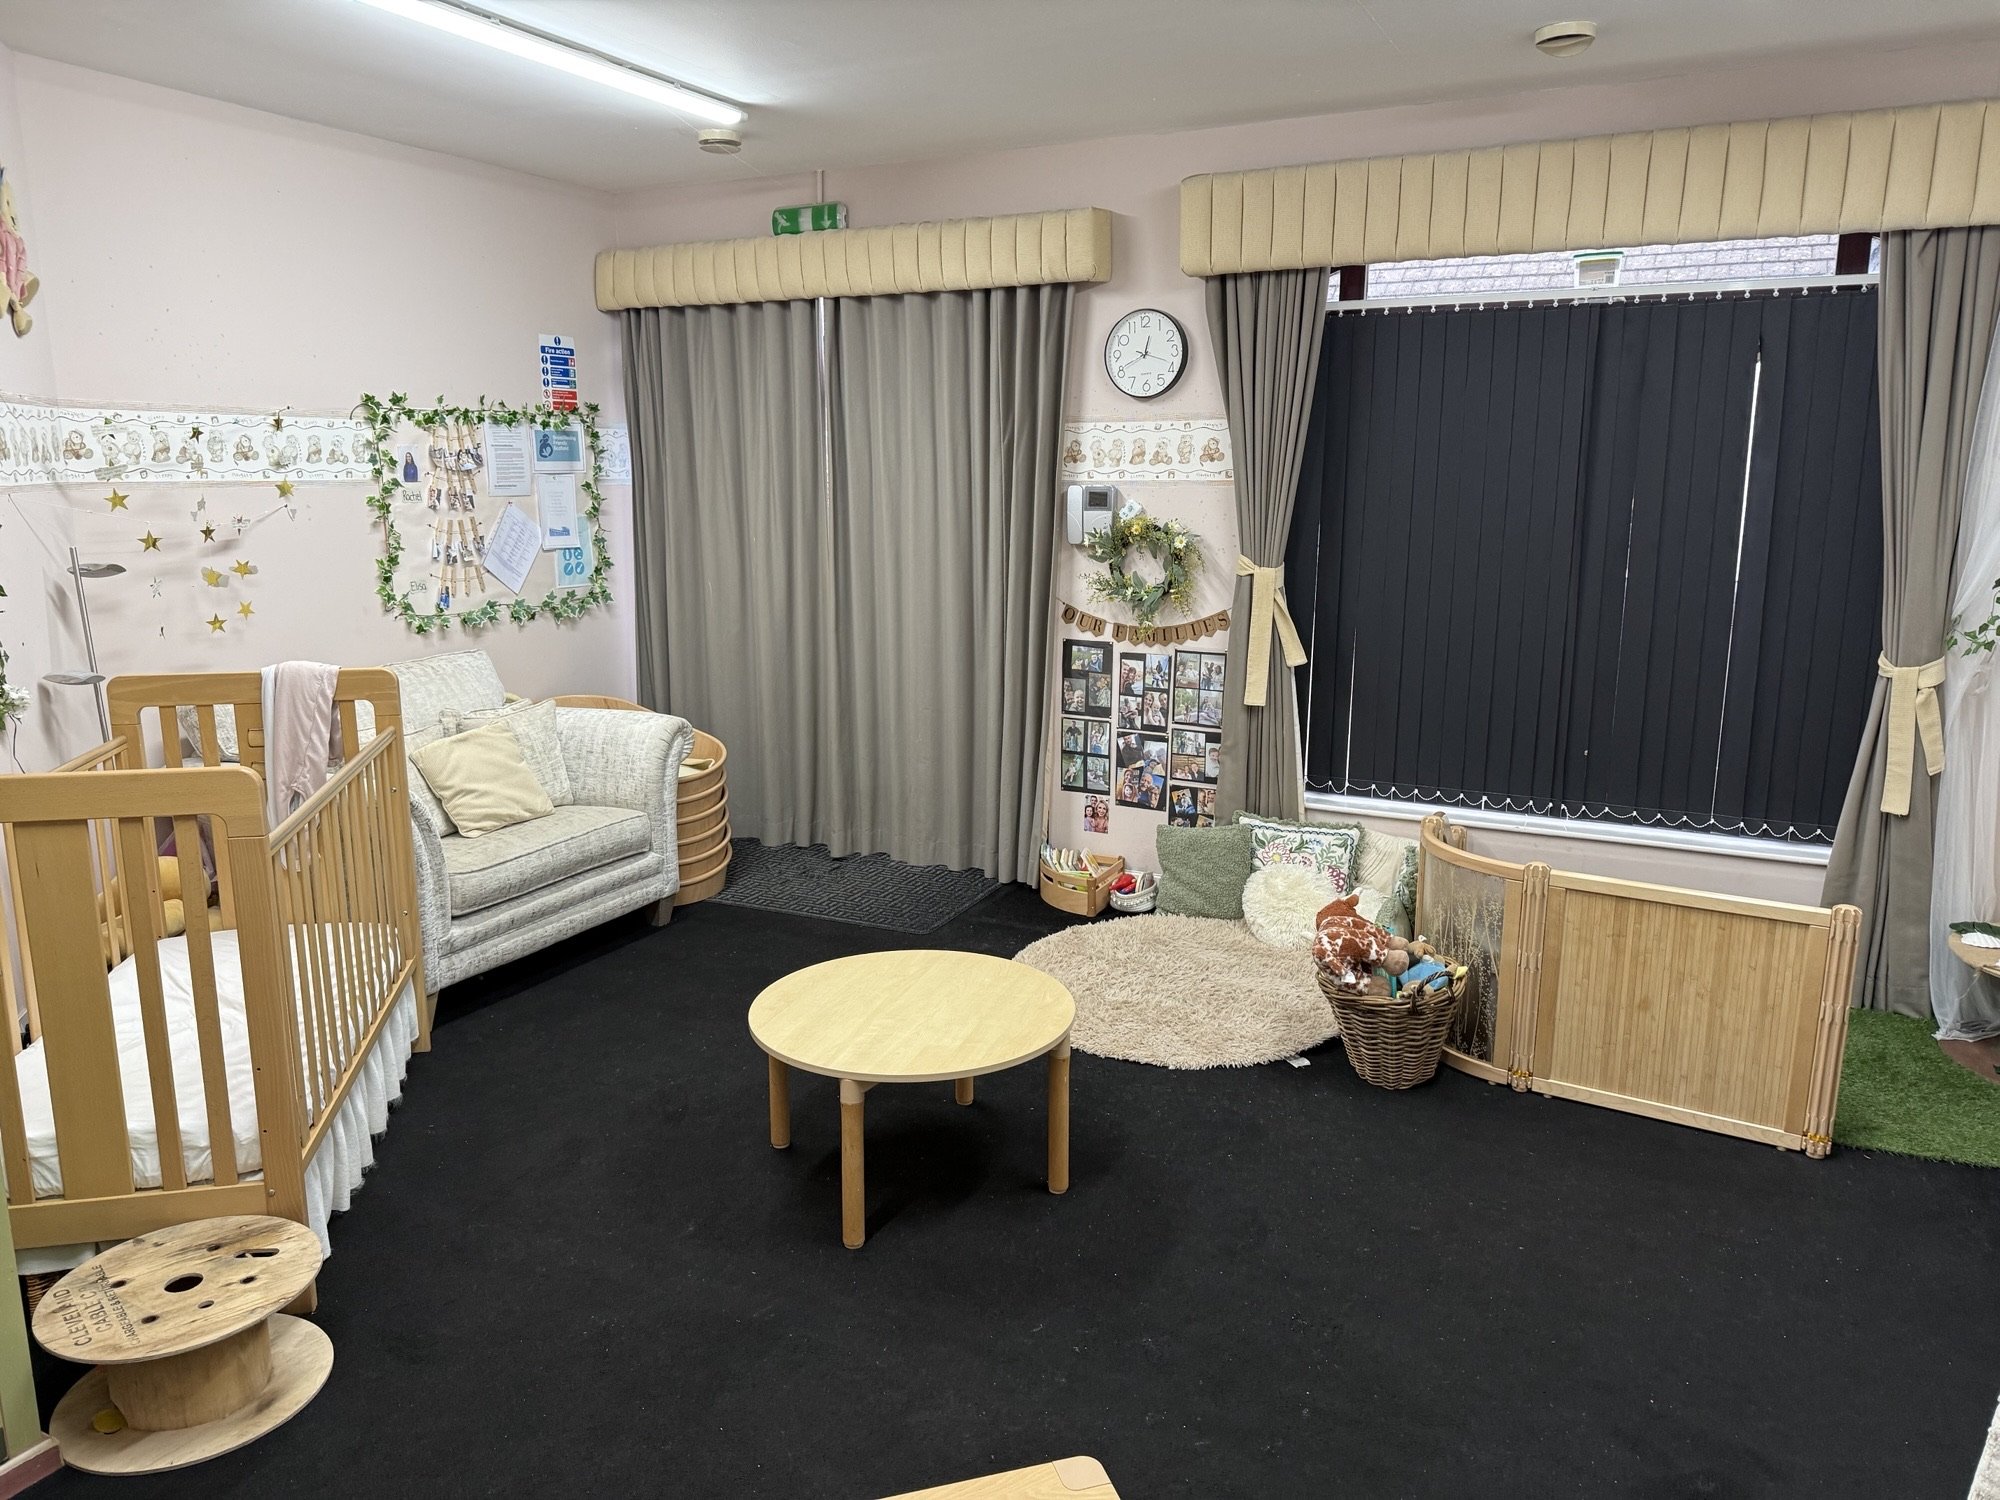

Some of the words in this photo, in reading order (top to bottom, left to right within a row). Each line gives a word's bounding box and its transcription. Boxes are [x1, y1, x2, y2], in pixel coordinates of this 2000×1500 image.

[1128, 321, 1137, 334] 11
[1140, 315, 1151, 328] 12
[1117, 334, 1130, 347] 10
[1166, 330, 1175, 342] 2
[1113, 349, 1122, 362] 9
[1171, 344, 1179, 357] 3
[1117, 365, 1126, 379] 8
[1168, 362, 1175, 373] 4
[1128, 376, 1136, 390] 7
[1143, 379, 1151, 392] 6
[1157, 374, 1166, 386] 5
[402, 490, 423, 502] Rachel
[1063, 608, 1103, 632] OUR
[1115, 613, 1229, 642] FAMILIES
[53, 1289, 93, 1346] CLEVELAND
[84, 1298, 113, 1333] CABLE
